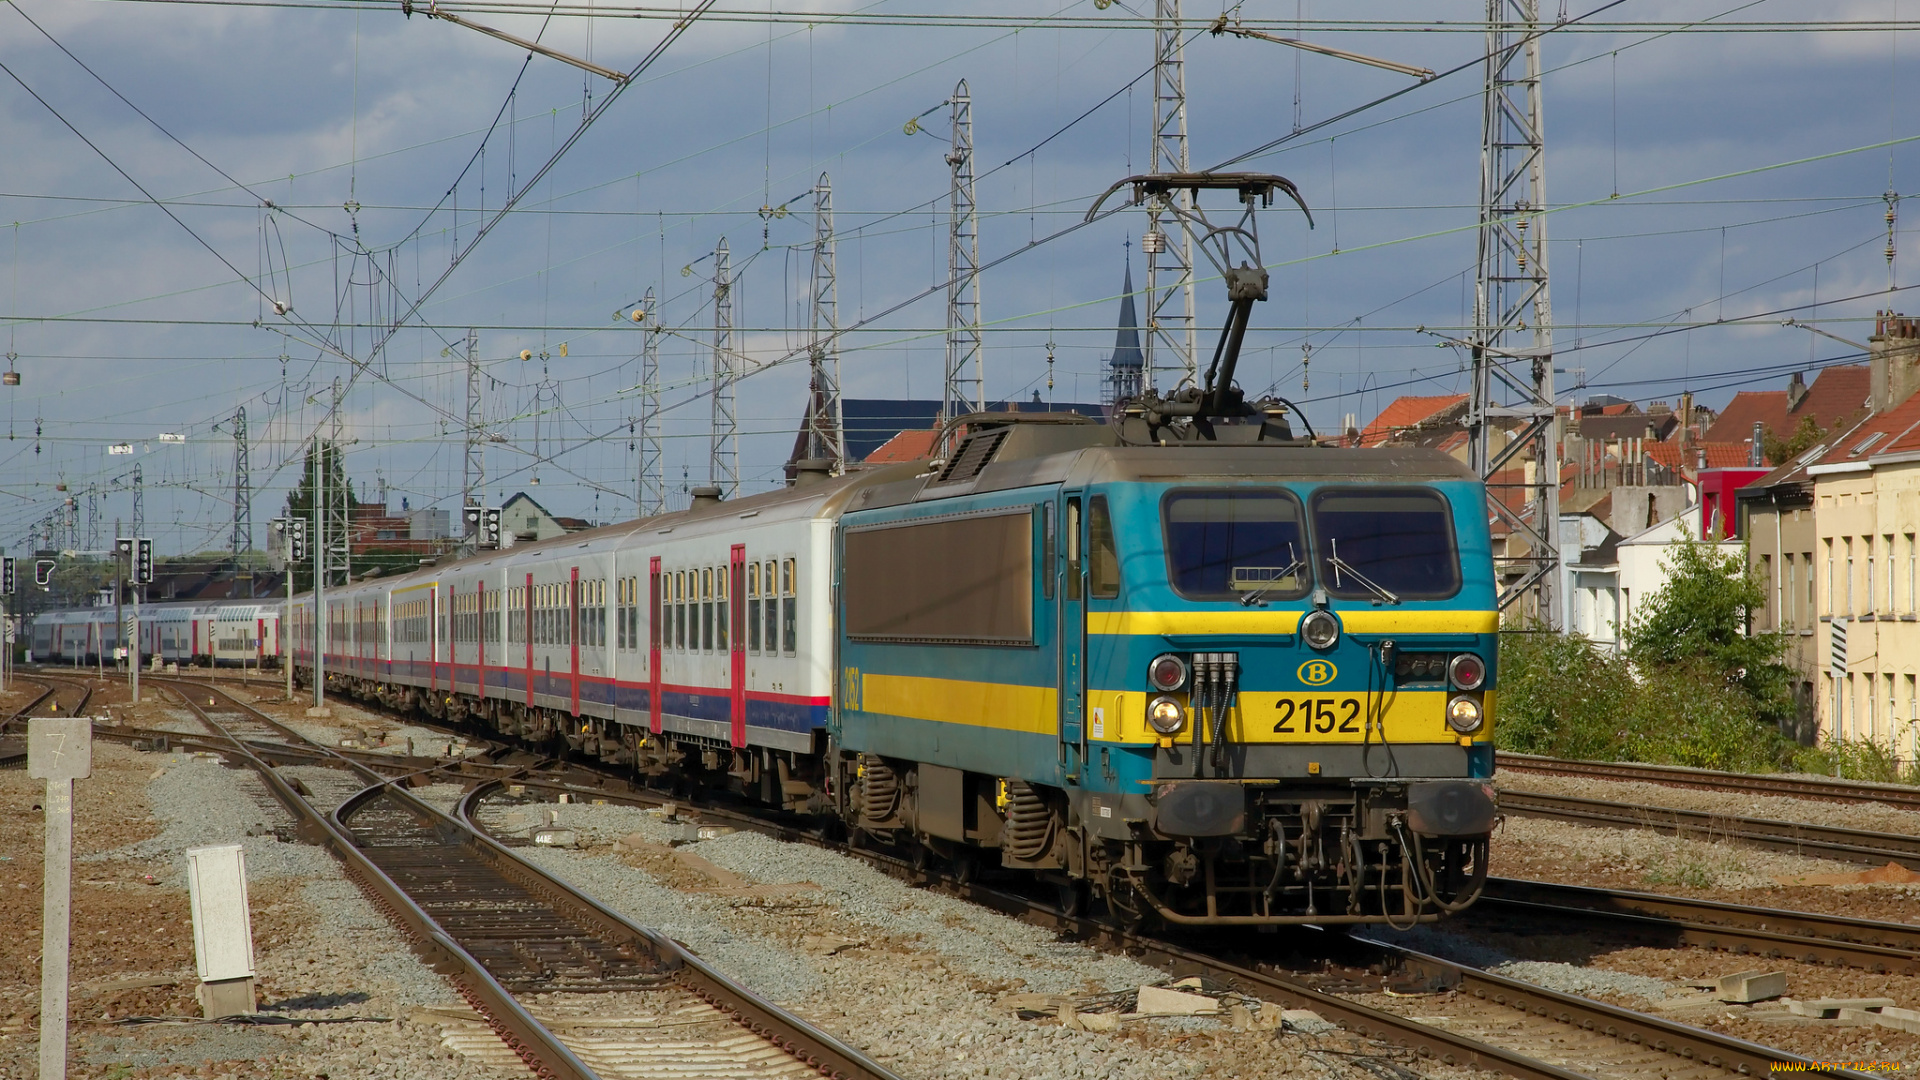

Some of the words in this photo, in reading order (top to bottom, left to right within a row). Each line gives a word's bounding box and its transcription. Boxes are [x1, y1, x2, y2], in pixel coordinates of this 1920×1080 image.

[1072, 653, 1076, 666] 2
[1307, 663, 1328, 683] B
[844, 666, 860, 711] 2152
[1273, 698, 1361, 734] 2152
[46, 733, 66, 769] 7
[535, 834, 552, 844] 44AE
